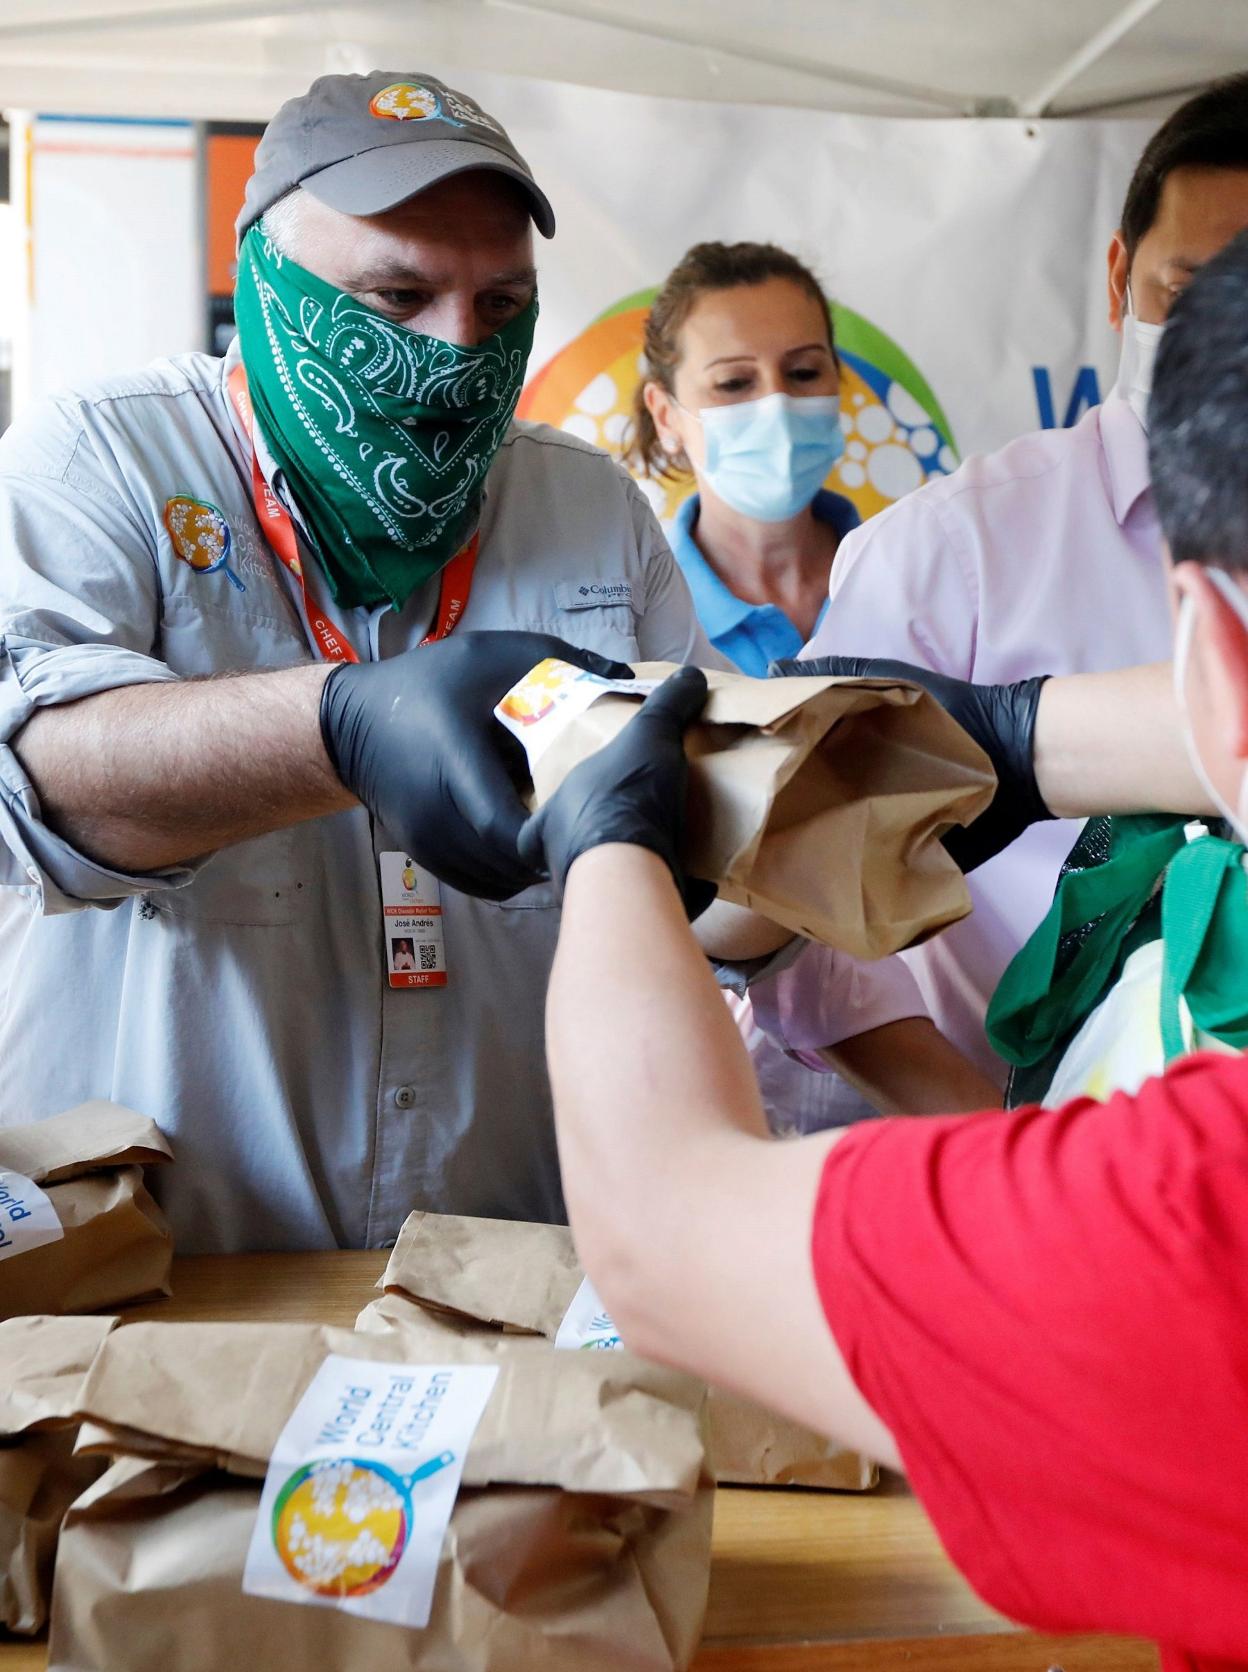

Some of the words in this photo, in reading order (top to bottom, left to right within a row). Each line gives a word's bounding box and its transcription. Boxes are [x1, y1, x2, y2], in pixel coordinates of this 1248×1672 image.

[315, 620, 342, 656] CHEF
[408, 976, 429, 984] STAFF
[0, 1186, 32, 1222] orld
[315, 1385, 372, 1445] World
[356, 1374, 416, 1446] Central
[391, 1372, 453, 1450] Kitchen
